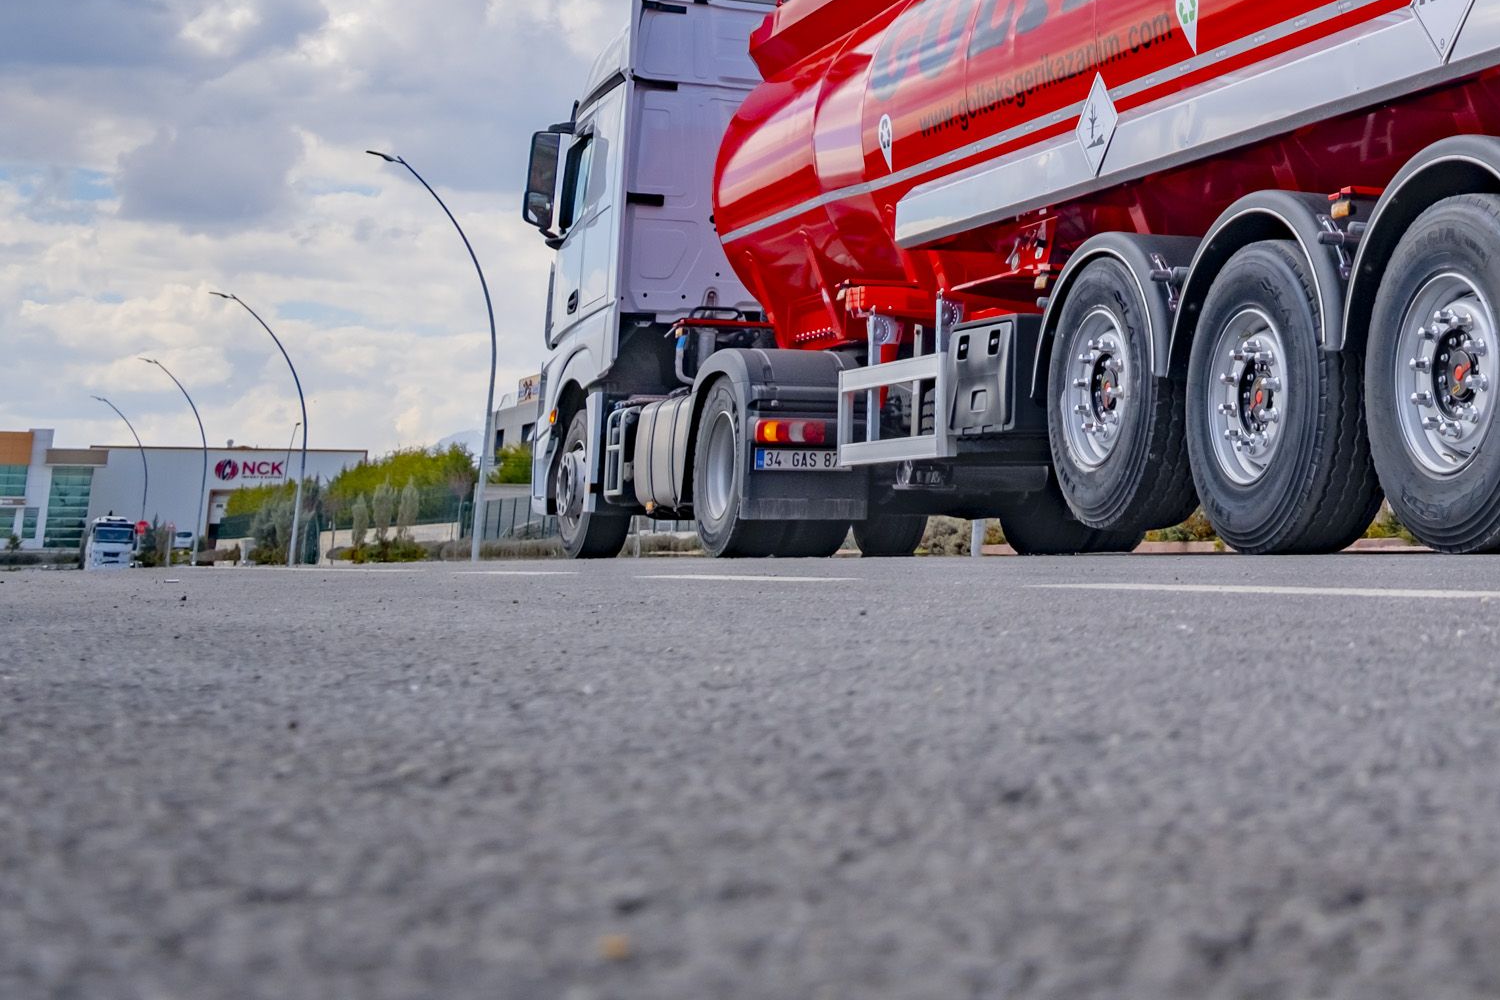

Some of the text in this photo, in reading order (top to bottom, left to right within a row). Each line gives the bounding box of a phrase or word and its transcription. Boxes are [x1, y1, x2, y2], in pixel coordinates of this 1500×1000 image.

[765, 451, 839, 468] 34 GAS 87
[242, 461, 284, 476] NCK
